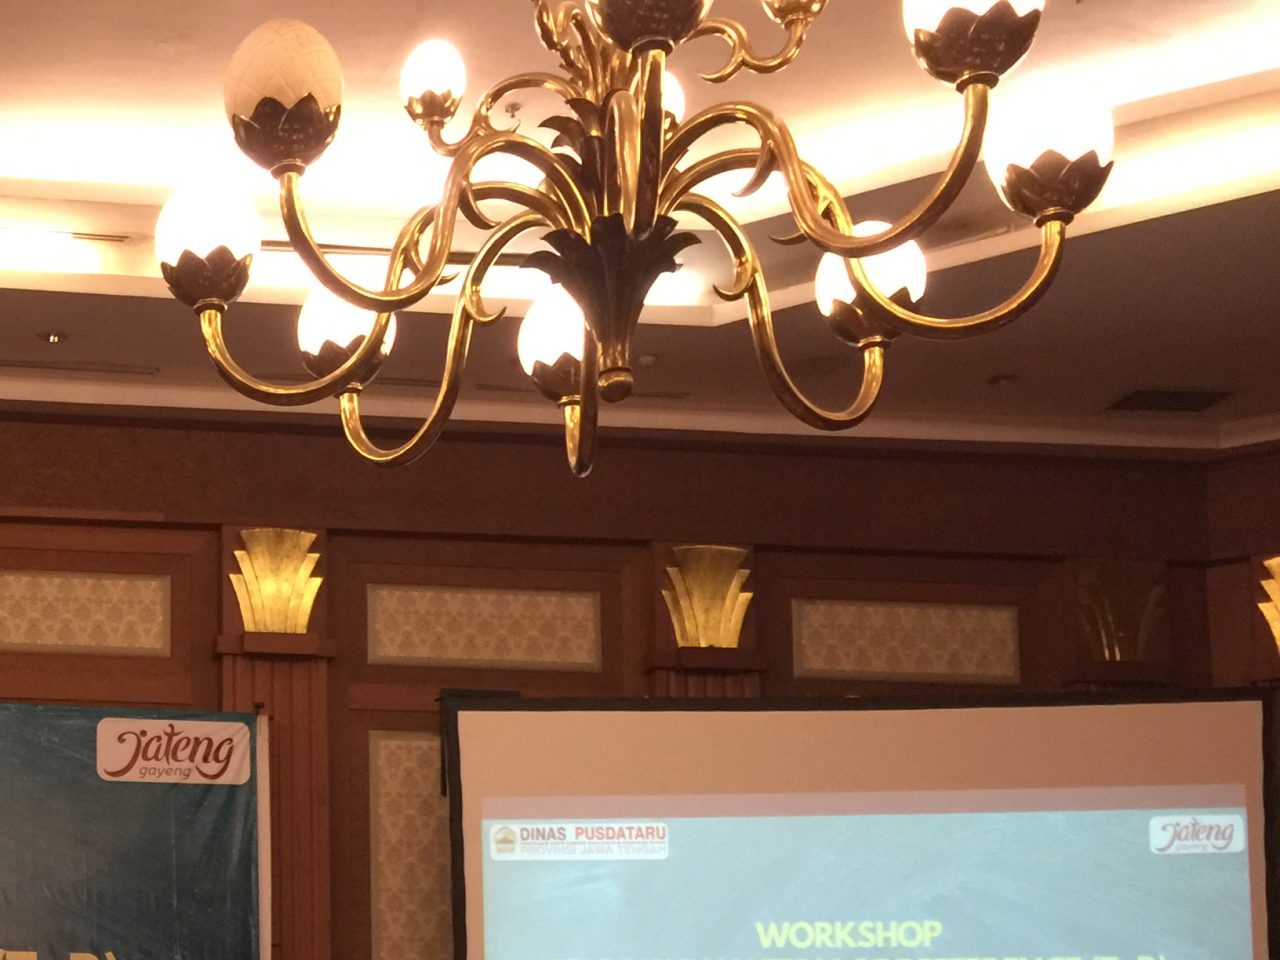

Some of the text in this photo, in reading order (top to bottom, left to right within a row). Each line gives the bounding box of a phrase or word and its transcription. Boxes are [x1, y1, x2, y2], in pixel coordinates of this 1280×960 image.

[104, 723, 234, 780] Jateng
[139, 766, 192, 780] gayeng
[520, 826, 666, 841] DINAS PUSDATARU
[1156, 817, 1235, 852] Jateng
[755, 920, 943, 949] WORKSHOP
